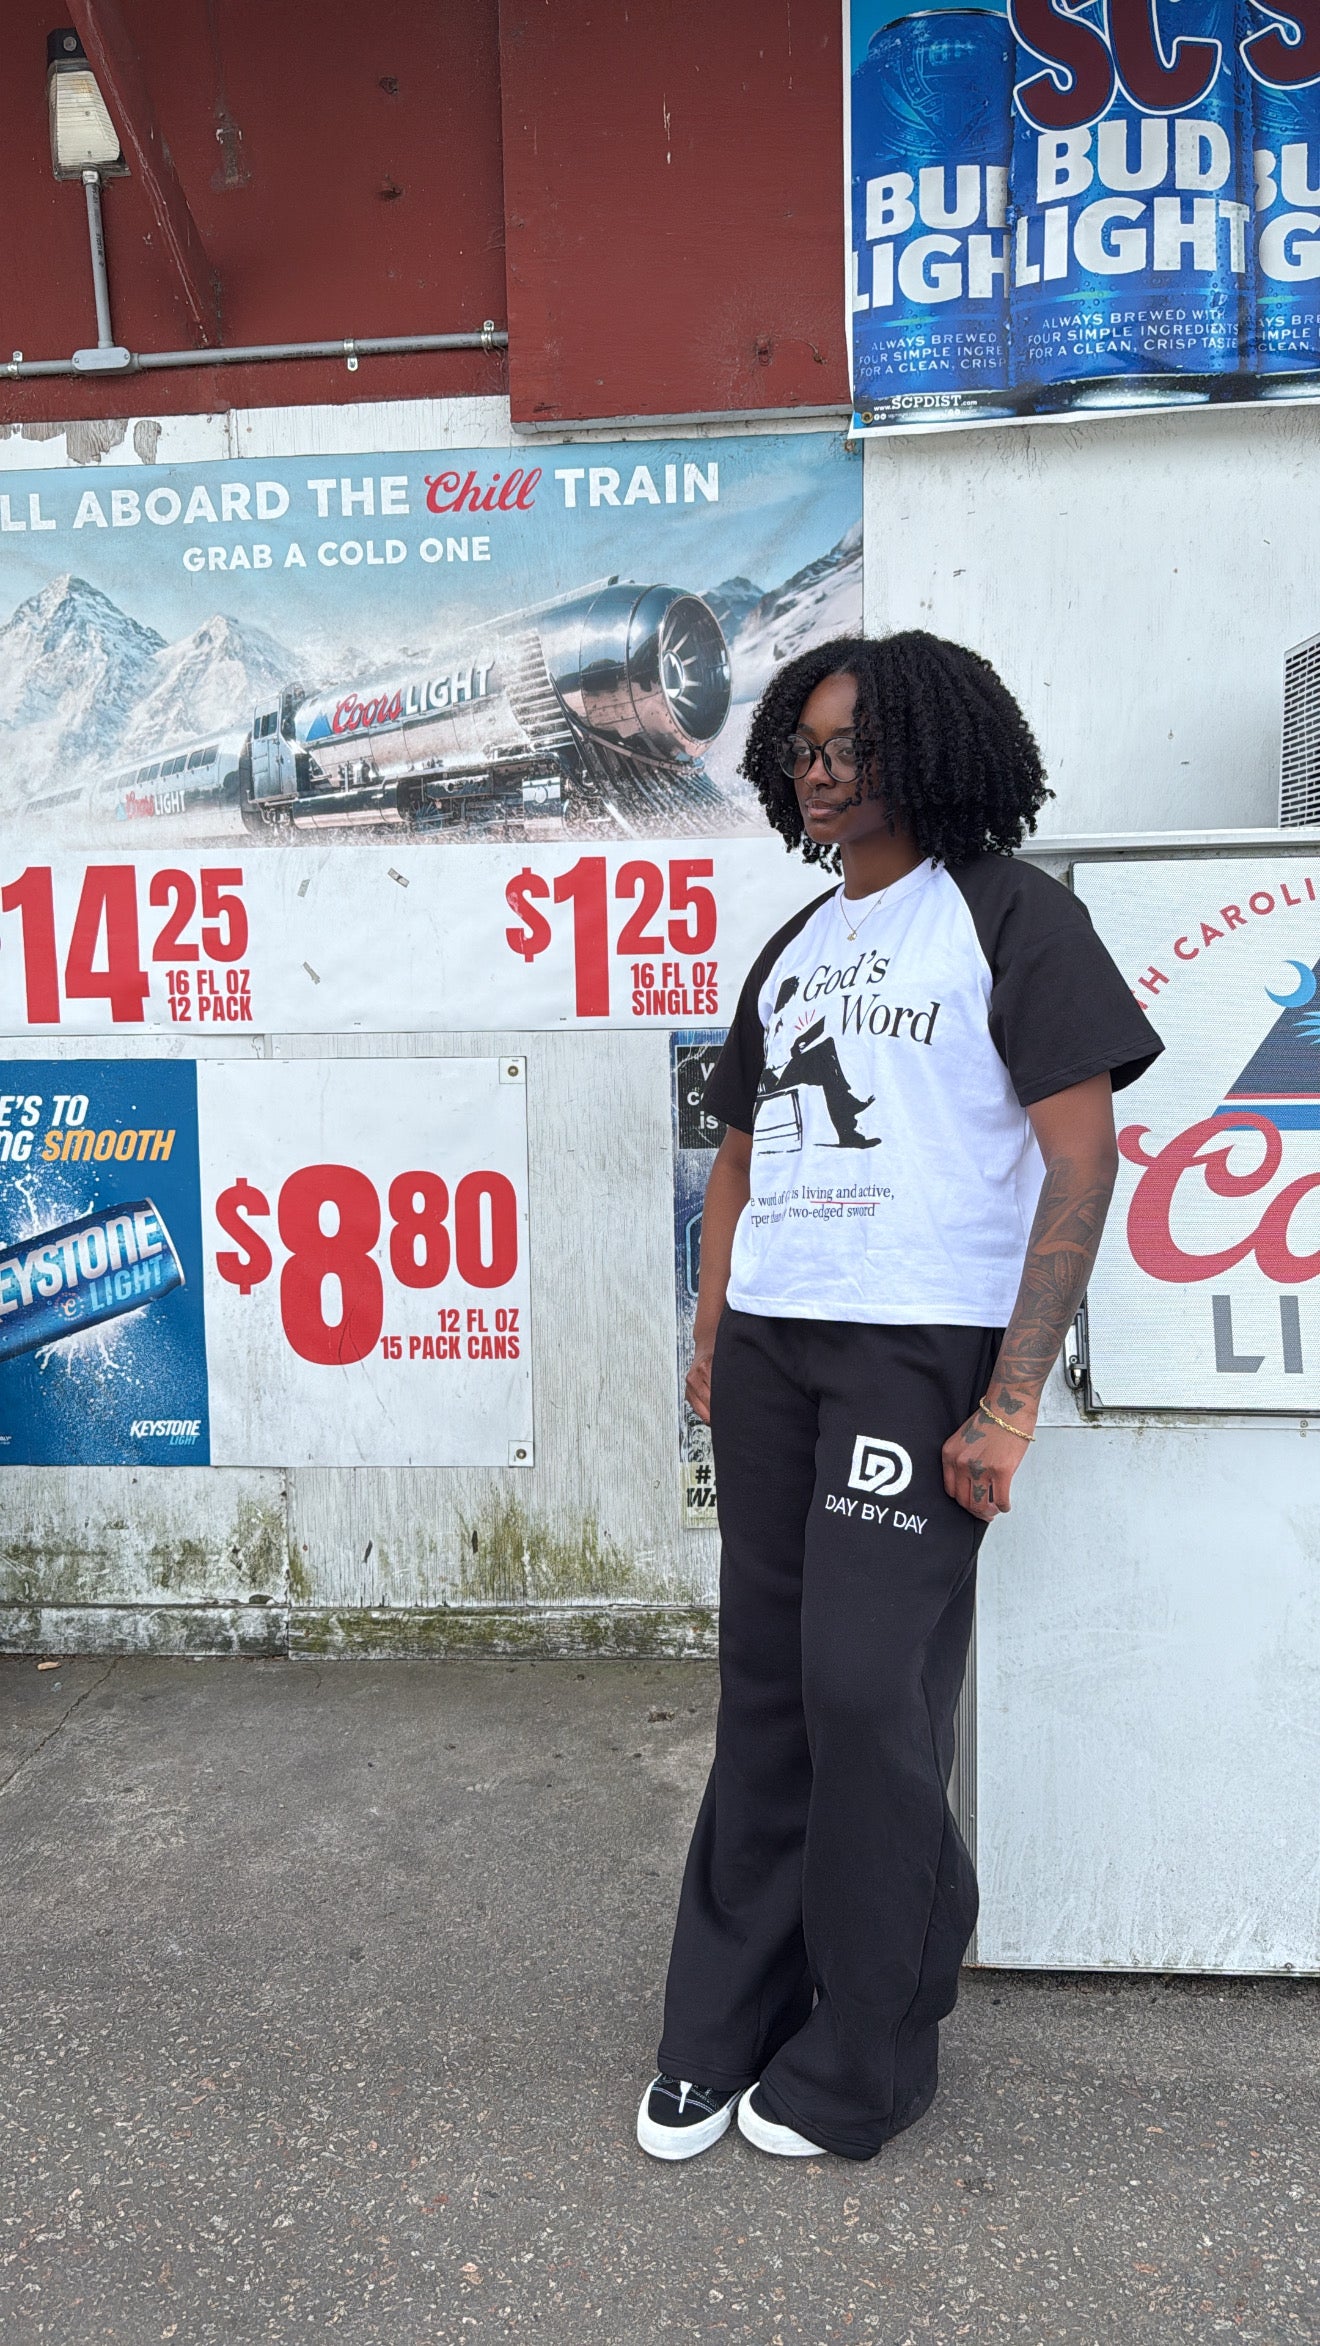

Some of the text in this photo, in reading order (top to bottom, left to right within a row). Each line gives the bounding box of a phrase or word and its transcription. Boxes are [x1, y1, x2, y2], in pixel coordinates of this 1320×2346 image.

[1036, 118, 1231, 204] BUD
[1015, 197, 1250, 287] LIGHT
[1042, 309, 1225, 329] ALWAYS BREWED WITH
[871, 333, 997, 351] ALWAYS BREWED
[1028, 323, 1239, 345] FOUR SIMPLE INGREDIENTS
[1258, 341, 1314, 352] CLEAN,
[859, 345, 1004, 365] FOUR SIMPLE INGRE
[1029, 347, 1053, 359] FOR
[1057, 345, 1067, 356] A
[1073, 339, 1137, 355] CLEAN,
[1144, 338, 1197, 351] CRISP
[860, 358, 1006, 377] FOR A CLEAN, CRISP
[874, 394, 977, 411] www.SCPDIST.com
[0, 462, 719, 531] LL ABOARD THE Chill TRAIN
[182, 536, 491, 572] GRAB A COLD ONE
[332, 661, 495, 734] Coors LIGHT
[155, 790, 186, 815] LIGHT
[1174, 877, 1316, 960] CAROLI
[165, 969, 251, 995] 16 FL OZ
[630, 962, 718, 988] 16 FL OZ
[803, 950, 891, 1002] God's
[168, 996, 253, 1022] 12 PACK
[632, 989, 718, 1016] SINGLES
[842, 994, 941, 1046] Word
[51, 1095, 89, 1127] TO
[687, 1091, 704, 1106] c
[700, 1111, 719, 1129] is
[42, 1129, 176, 1162] SMOOTH
[802, 1185, 833, 1201] living
[836, 1184, 857, 1199] and
[858, 1184, 895, 1200] active,
[1117, 1111, 1320, 1284] Co
[789, 1203, 843, 1221] two-edged
[846, 1203, 875, 1217] sword
[89, 1254, 164, 1312] LIGHT
[438, 1308, 519, 1332] 12 FL OZ
[380, 1335, 520, 1360] 15 PACK CANS
[1211, 1295, 1304, 1374] LI
[130, 1420, 201, 1438] KEYSTONE
[169, 1435, 197, 1446] LIGHT
[825, 1494, 928, 1535] DAY BY DAY
